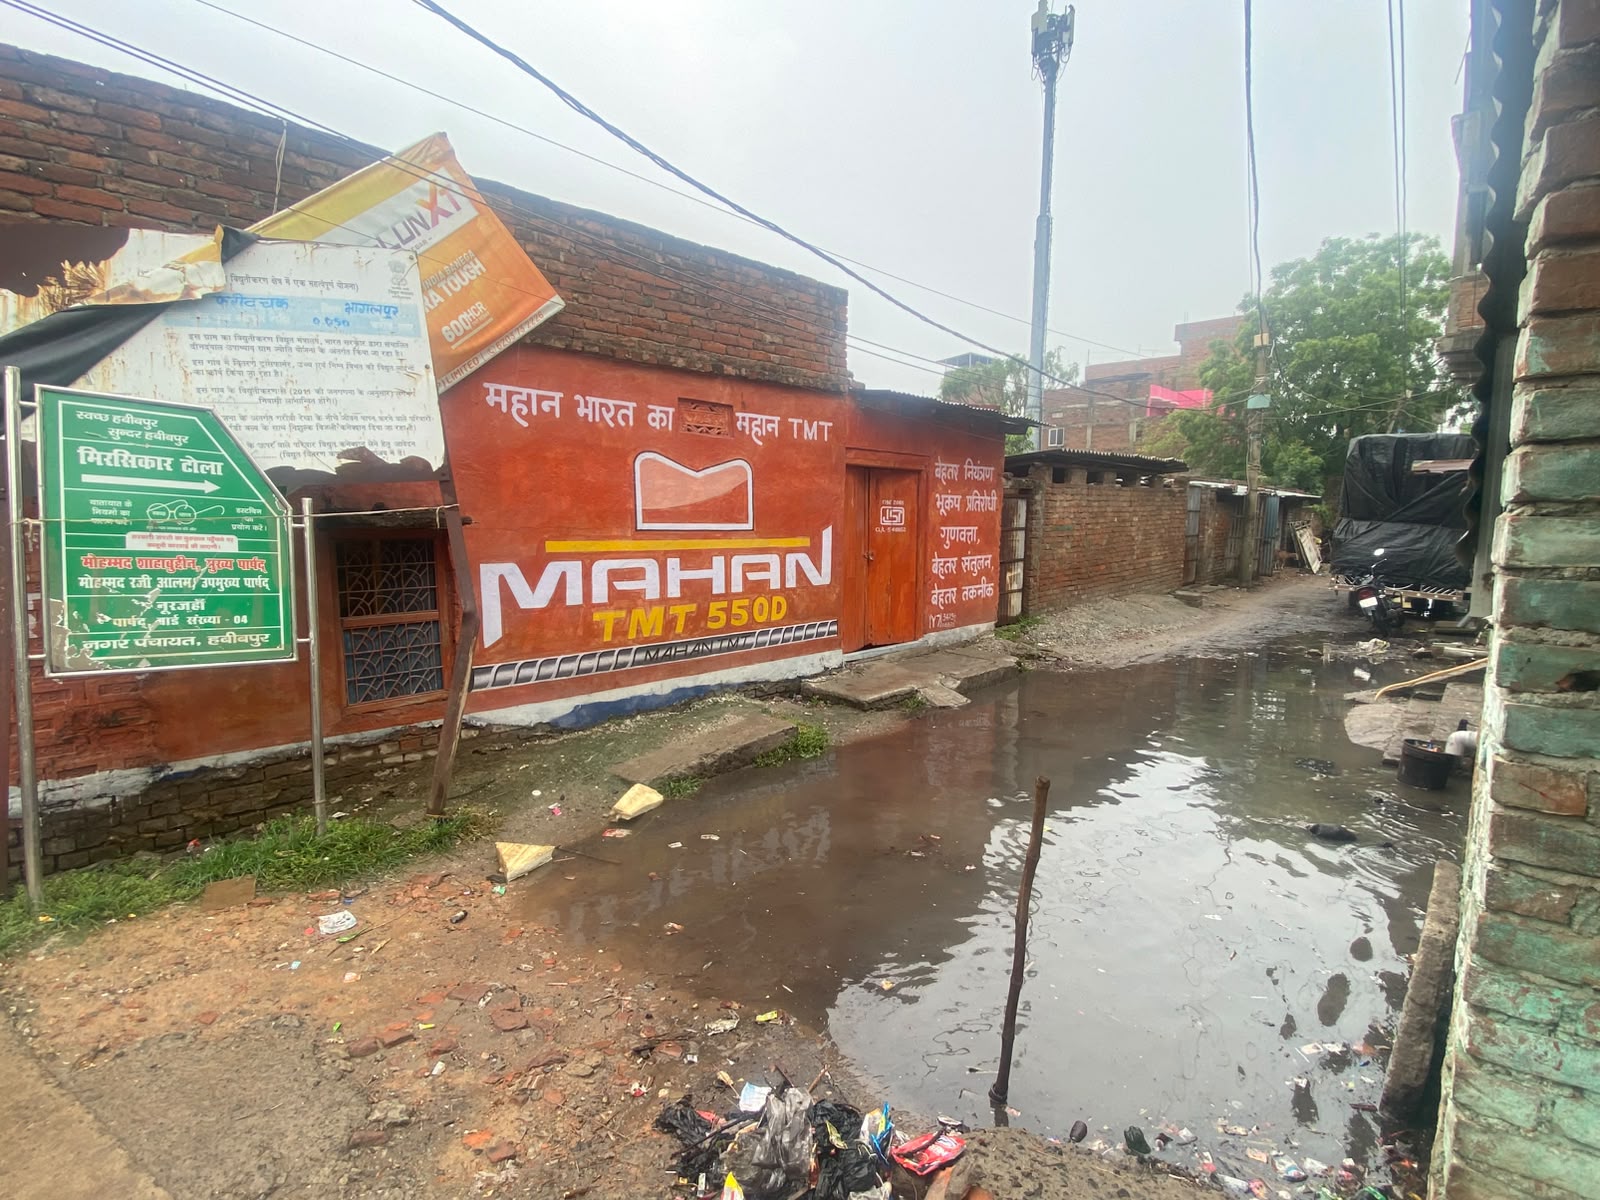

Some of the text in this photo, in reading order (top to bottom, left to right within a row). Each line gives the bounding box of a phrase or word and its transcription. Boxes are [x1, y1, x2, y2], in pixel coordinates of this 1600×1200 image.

[444, 249, 476, 274] BANEGA
[293, 279, 306, 288] एक
[437, 257, 487, 297] TOUGH
[446, 356, 480, 384] LIMITED
[483, 382, 834, 446] महान भारत का महान TMT
[107, 428, 142, 440] सुन्दर
[77, 446, 224, 475] मिरसिकार टोला
[934, 455, 960, 485] बेहतर
[935, 489, 998, 517] भूकंप प्रतिरोधी
[81, 553, 133, 570] मोहम्मद
[205, 557, 234, 574] मुख्य
[931, 551, 958, 580] बेहतर
[78, 574, 125, 589] मोहम्मद
[129, 574, 152, 589] रजी
[201, 576, 240, 591] उपमुख्य
[479, 525, 833, 649] MAHAN
[931, 576, 995, 610] बेहतर तकनीक
[186, 614, 221, 625] संख्या
[233, 615, 248, 625] 04
[593, 596, 788, 642] TMT 550D
[82, 638, 130, 651] नगर
[644, 635, 751, 661] MAHAN TMT
